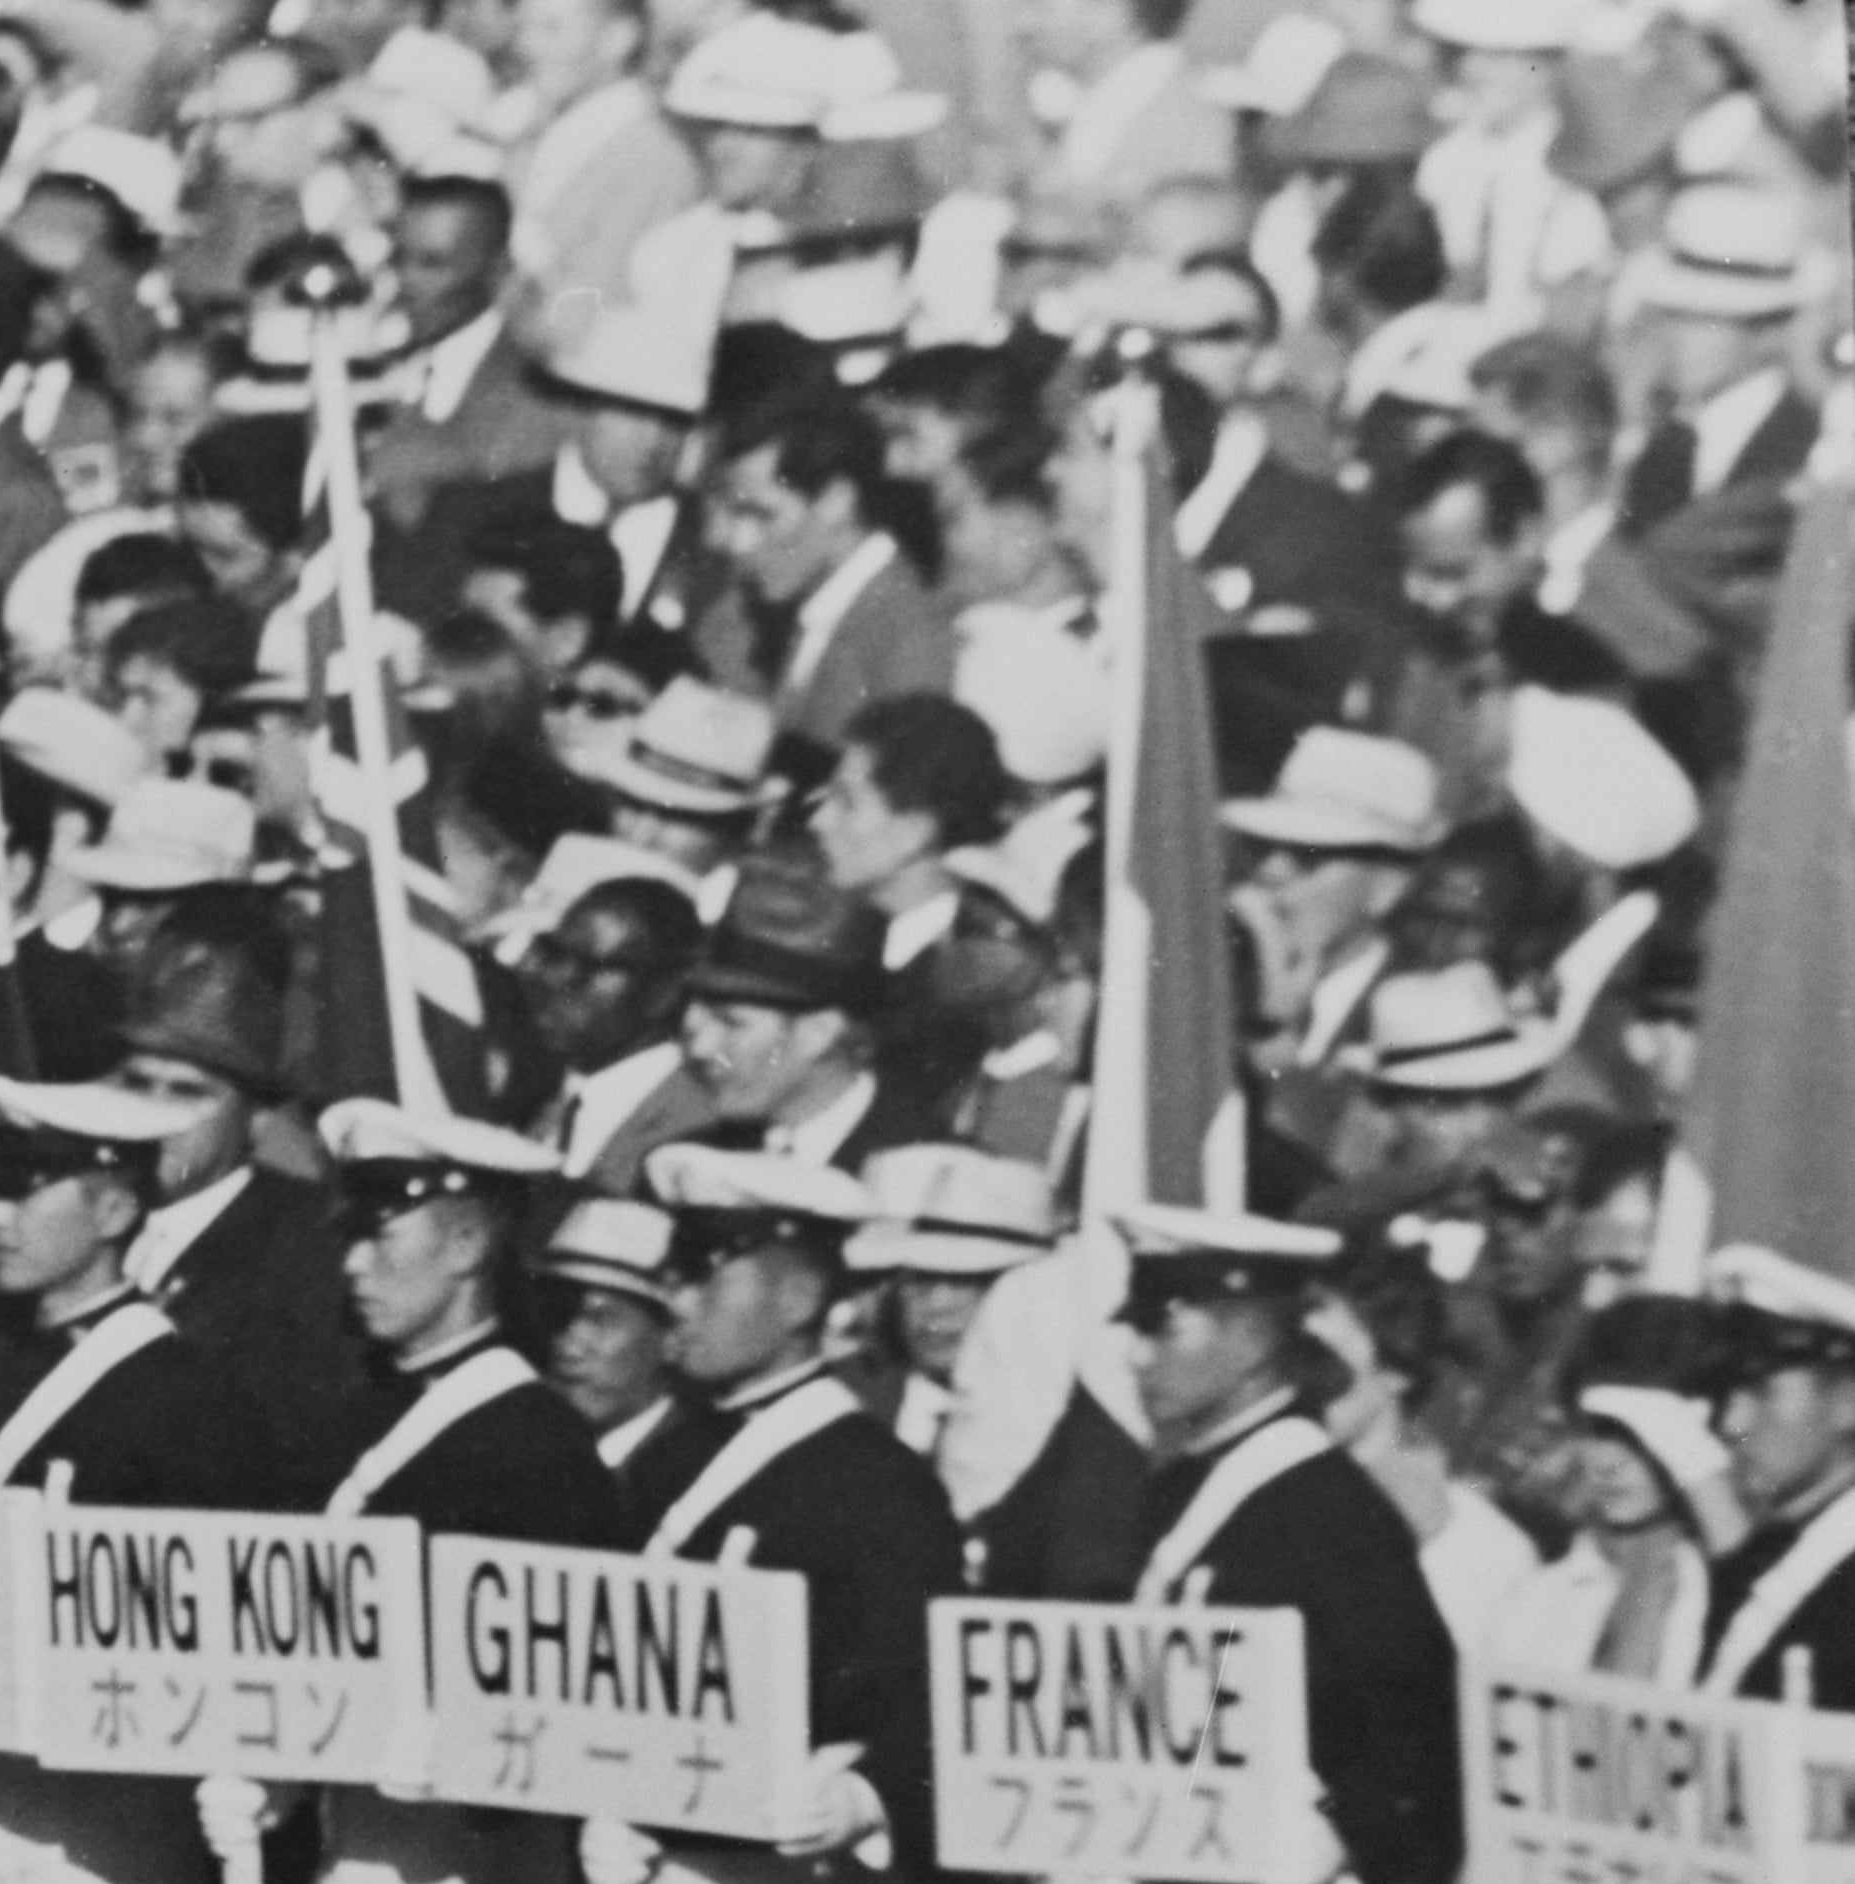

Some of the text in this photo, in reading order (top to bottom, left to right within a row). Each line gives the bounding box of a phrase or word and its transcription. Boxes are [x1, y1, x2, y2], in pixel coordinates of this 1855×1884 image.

[47, 1531, 381, 1660] HONG KONG
[466, 1562, 736, 1724] GHANA
[91, 1667, 349, 1756] ホンコン
[958, 1617, 1248, 1768] FRANCE
[494, 1714, 725, 1814] ガーナ
[989, 1777, 1232, 1862] フランス
[1491, 1683, 1754, 1857] ETHIOPIA
